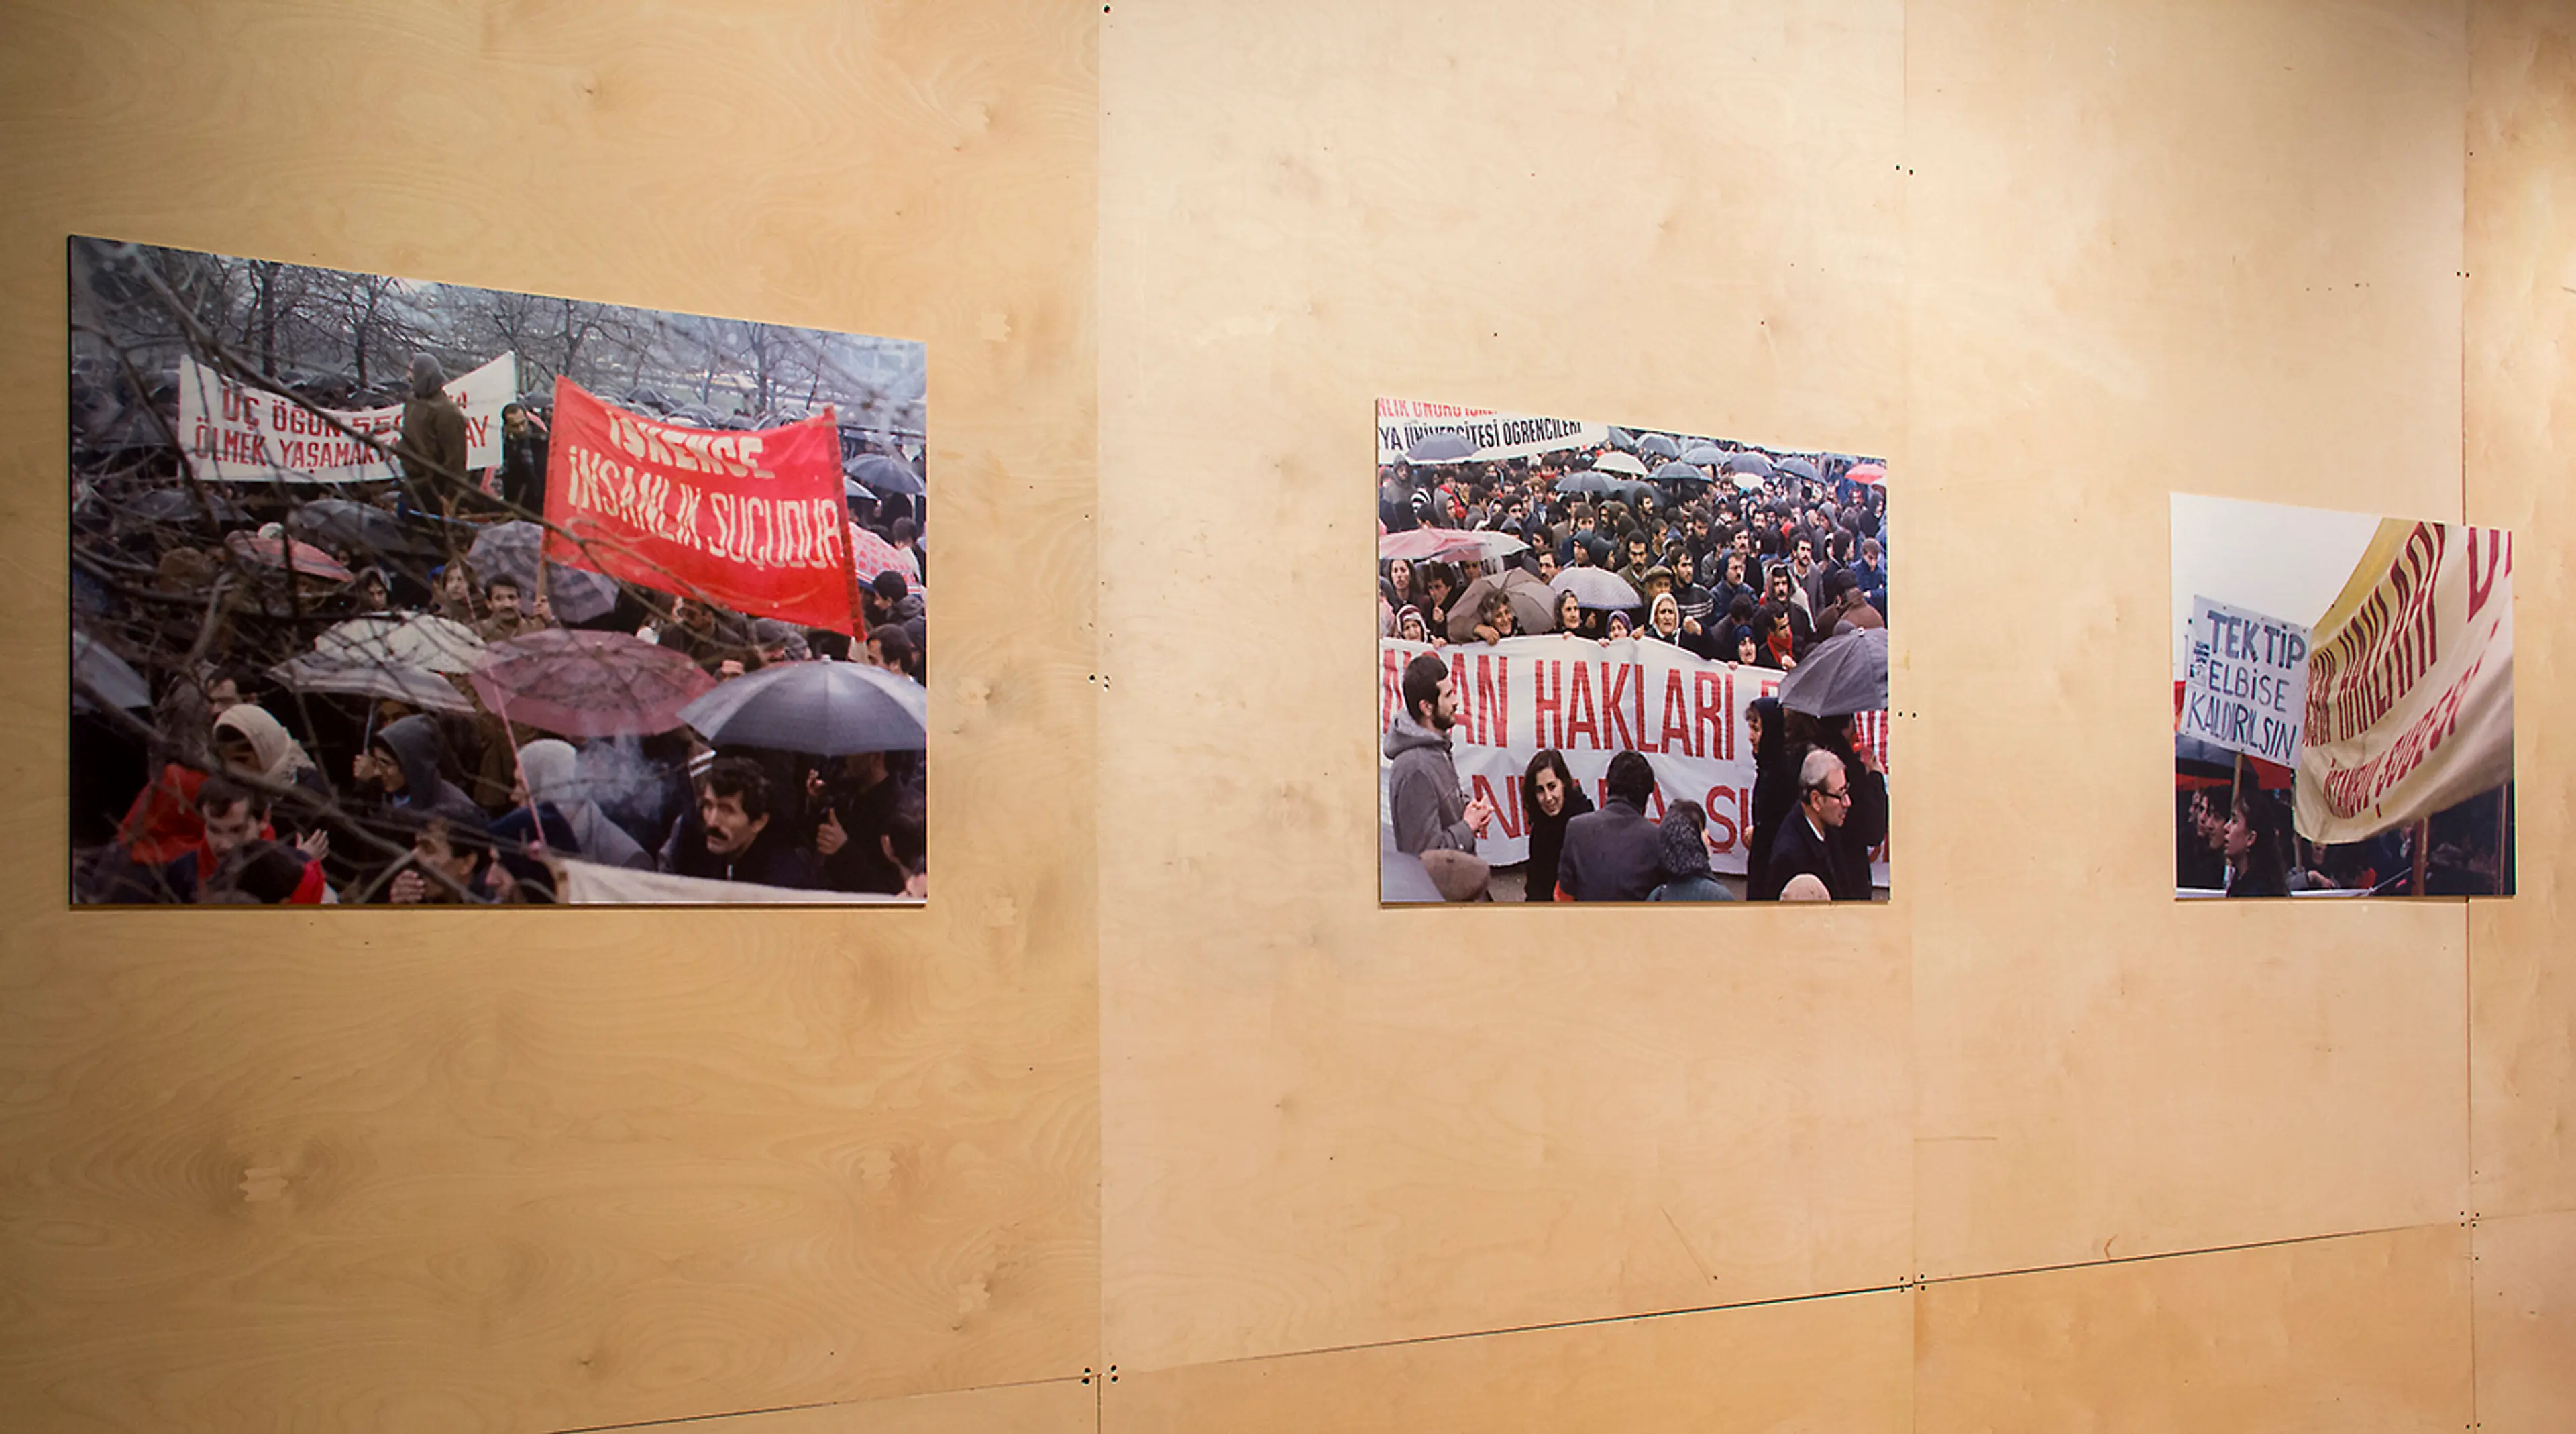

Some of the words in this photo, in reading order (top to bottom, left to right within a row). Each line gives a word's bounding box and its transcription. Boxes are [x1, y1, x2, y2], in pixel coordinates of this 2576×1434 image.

[195, 416, 267, 466] ÖLMEK
[606, 410, 775, 479] İŞKENCE
[568, 445, 702, 550] İNSANLIK
[708, 492, 845, 571] SUÇUDUR
[2337, 521, 2446, 742] HAKLARI
[1534, 656, 1735, 760] HAKLARI
[2209, 659, 2290, 713] ELBİSE
